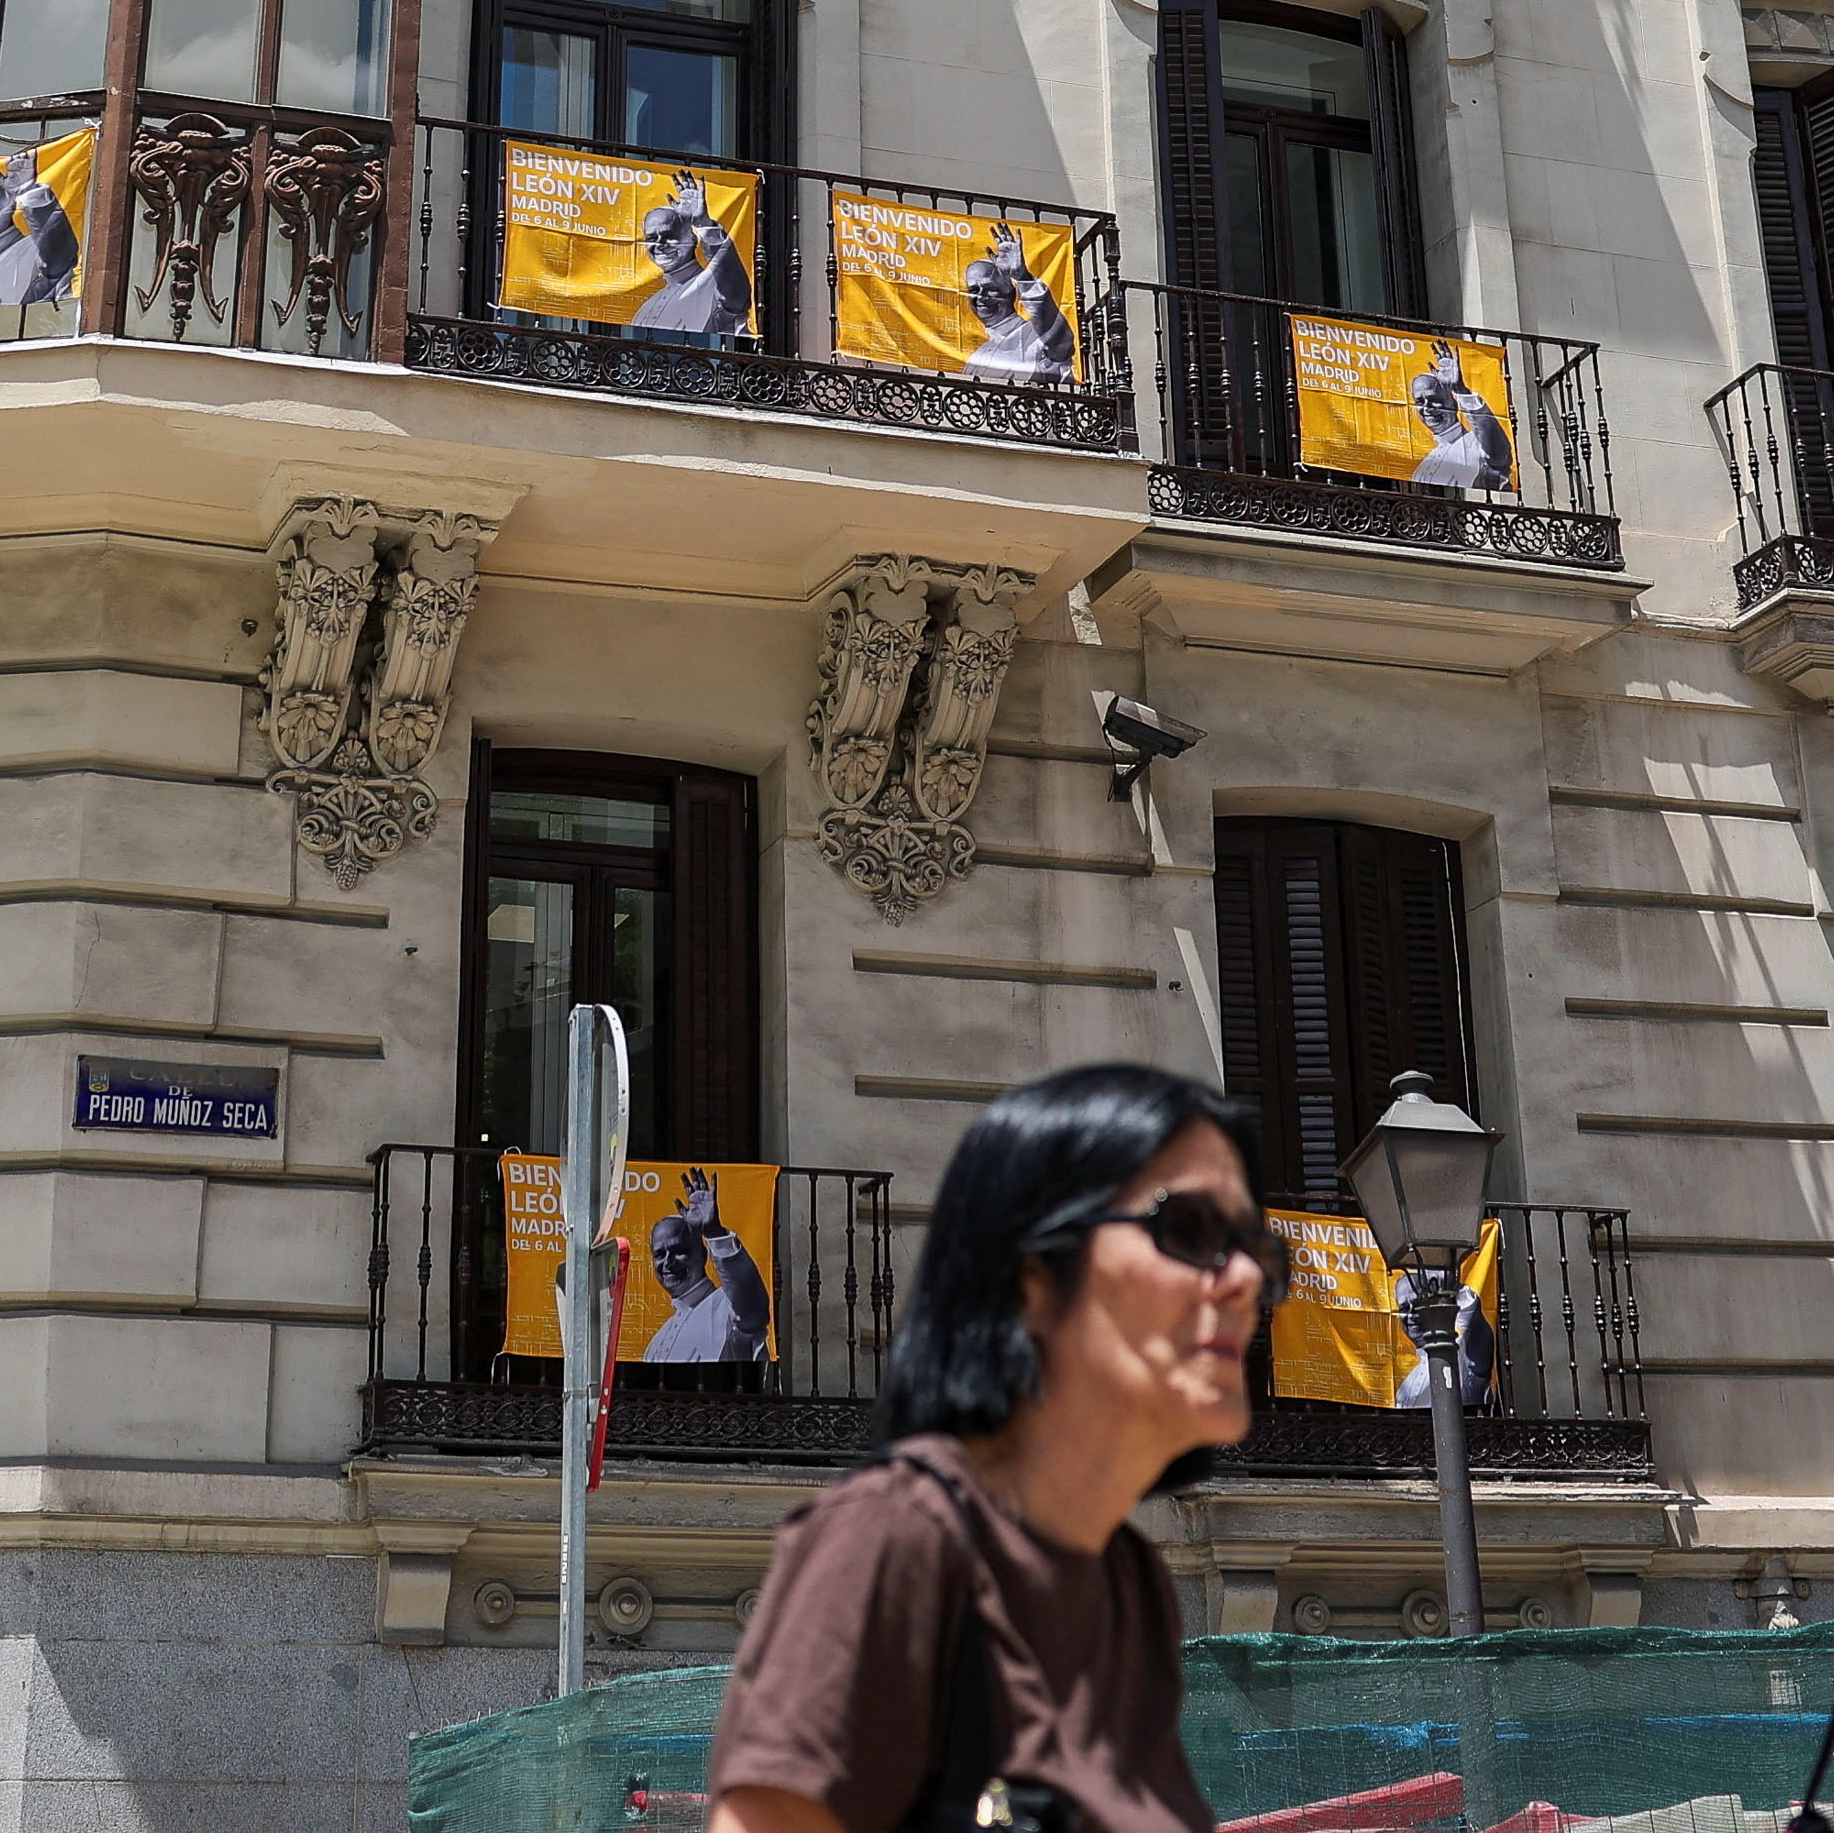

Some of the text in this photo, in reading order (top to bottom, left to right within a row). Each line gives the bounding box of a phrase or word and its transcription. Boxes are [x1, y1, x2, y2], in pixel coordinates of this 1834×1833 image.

[511, 147, 653, 185] BIENVENIDO
[512, 169, 620, 206] LEÓN XIV
[513, 197, 581, 219] MADRID
[839, 199, 972, 239] BIENVENIDO
[512, 213, 607, 236] DEL 6 AL 9 JUNIO
[841, 222, 942, 256] LEÓN XIV
[842, 244, 906, 269] MADRID
[842, 260, 863, 272] DEL
[864, 265, 872, 274] 6
[889, 267, 895, 279] 9
[898, 271, 931, 285] JUNIO
[1296, 320, 1414, 354] BIENVENIDO
[1299, 337, 1389, 370] LEÓN XIV
[1301, 360, 1361, 383] MADRID
[1302, 377, 1383, 398] DEL 6 AL 9 JUNIO
[168, 1084, 193, 1097] DE
[88, 1094, 268, 1131] PEDRO MUÑOZ SECA
[507, 1163, 661, 1193] BIENDO
[510, 1188, 564, 1214] LEÓ
[510, 1219, 565, 1236] MADR
[1269, 1217, 1378, 1249] BIENVENI
[511, 1238, 562, 1253] DEL 6 AL
[1335, 1253, 1371, 1274] XIV
[1288, 1271, 1338, 1292] ADRID
[1296, 1289, 1362, 1307] 6 AL 9 JUNIO
